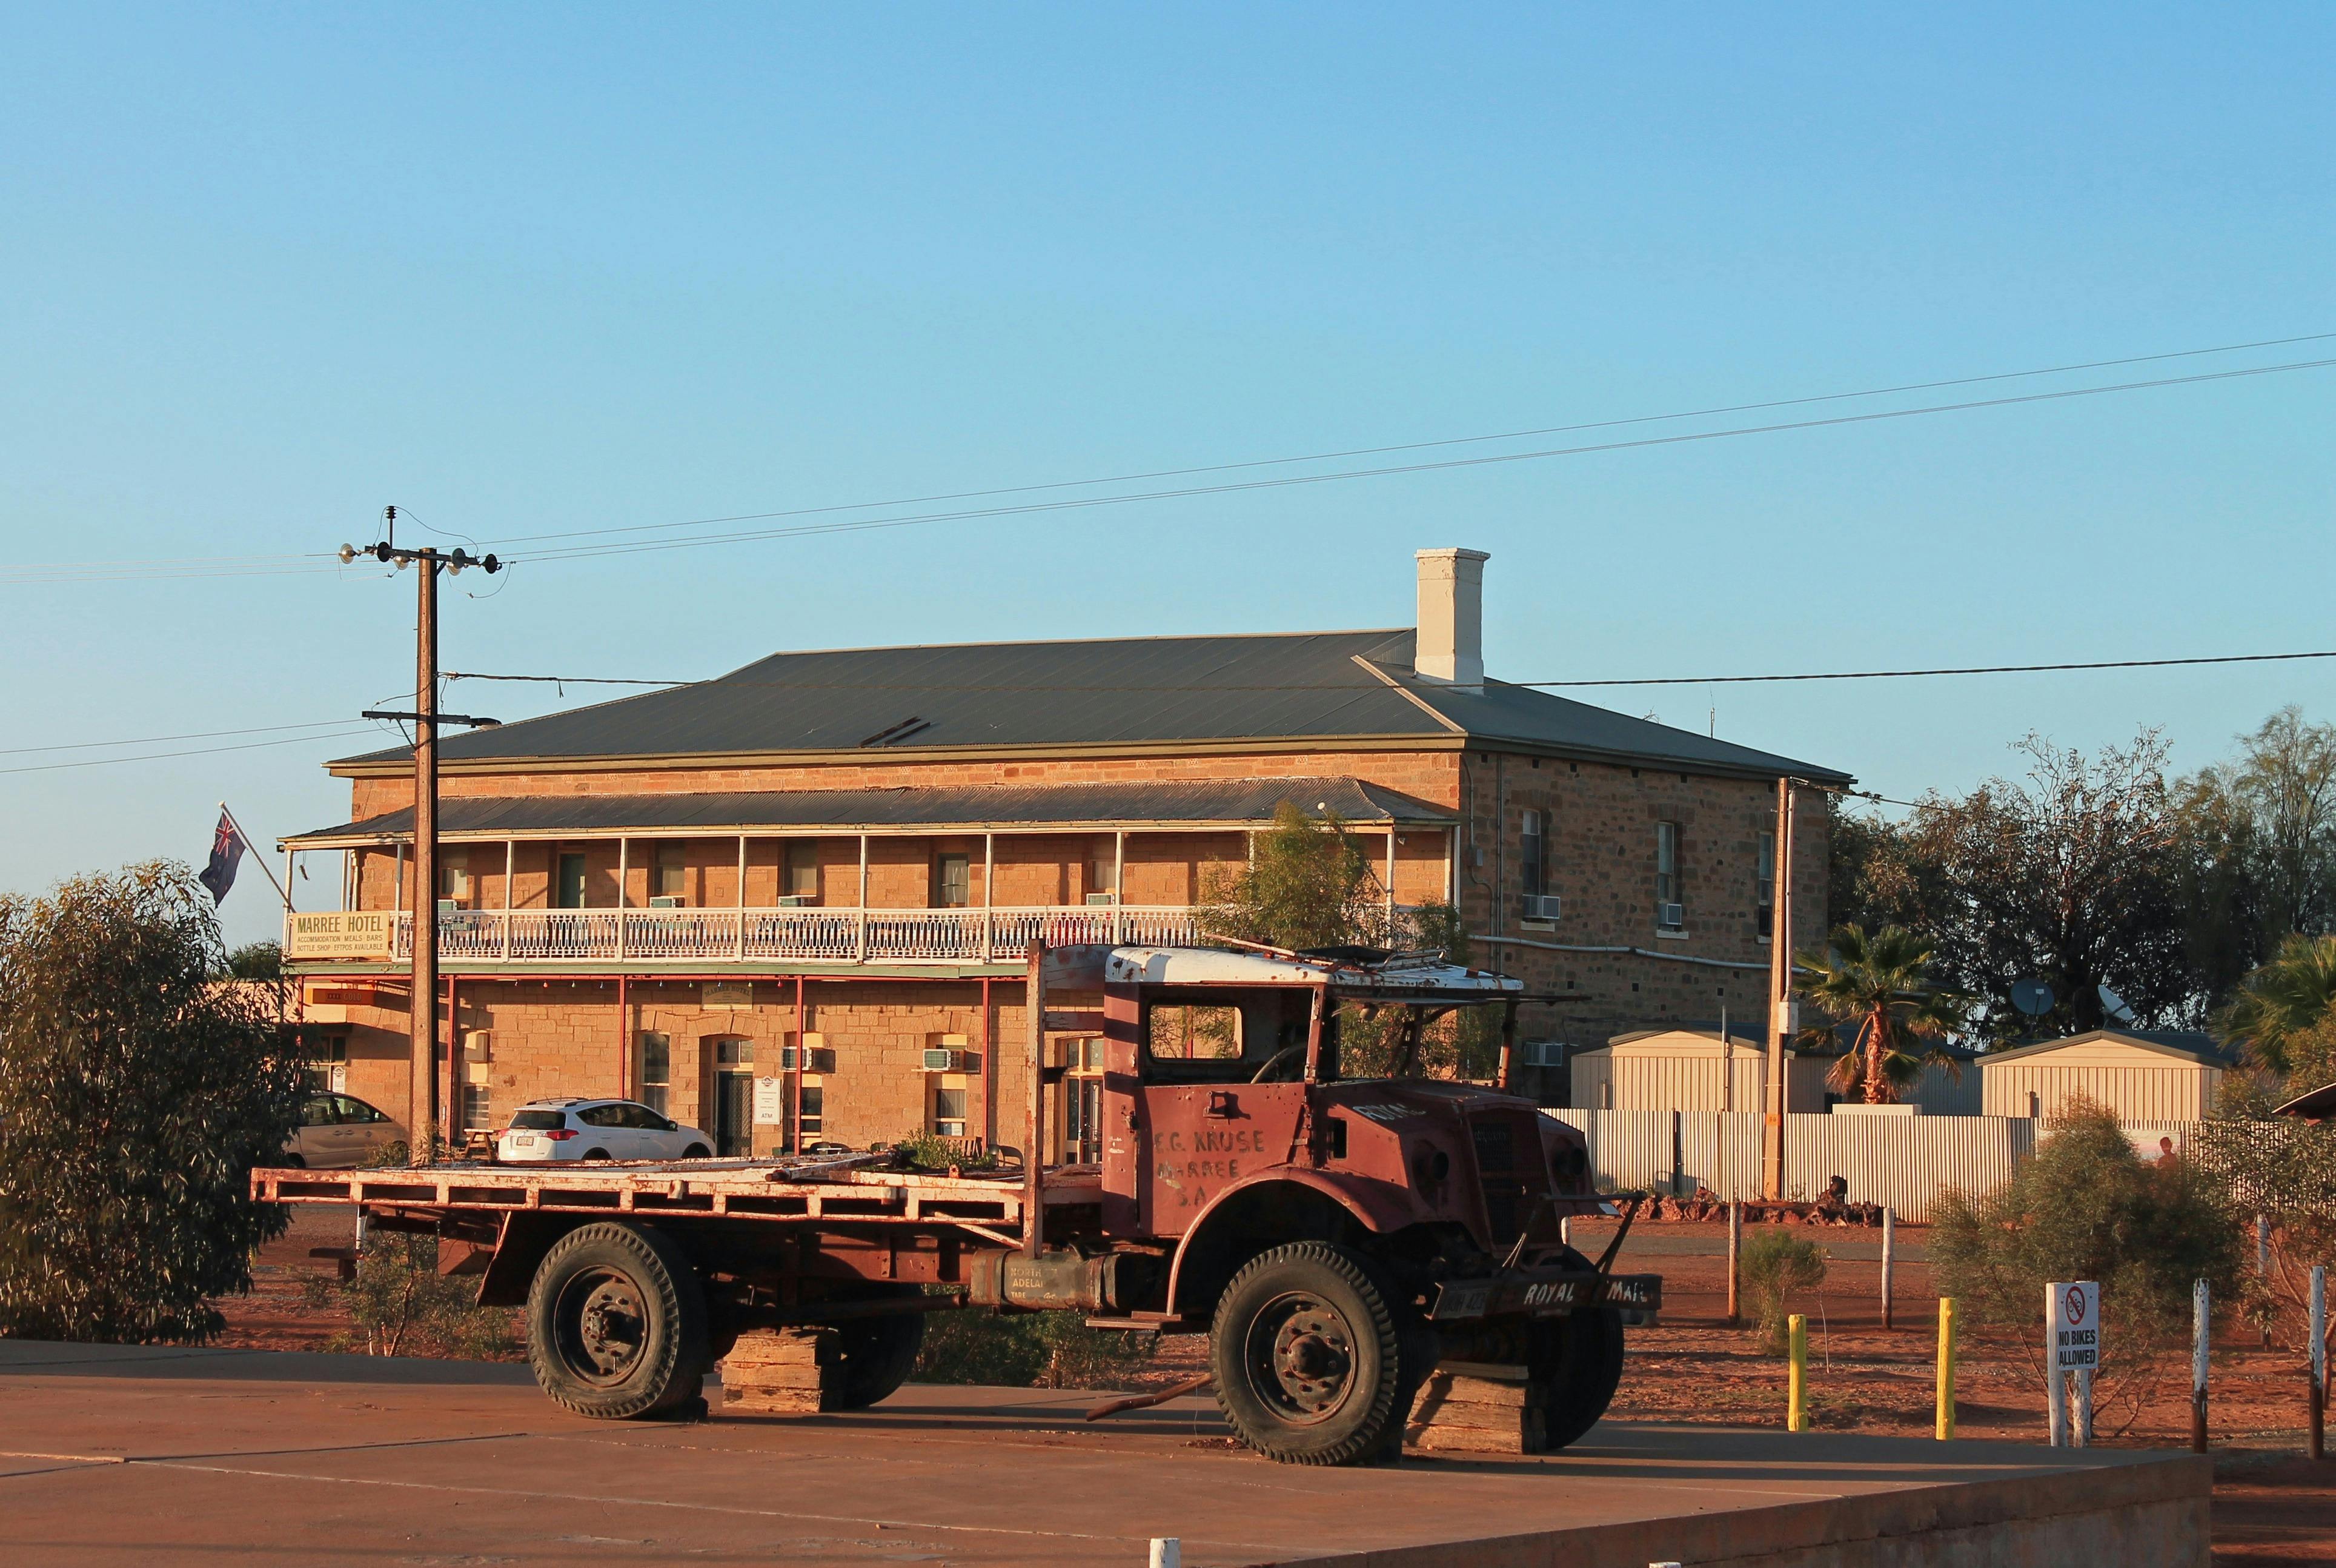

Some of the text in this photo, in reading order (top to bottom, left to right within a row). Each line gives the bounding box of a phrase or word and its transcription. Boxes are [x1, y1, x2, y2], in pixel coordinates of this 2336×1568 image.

[297, 915, 383, 933] MARREE HOTEL
[344, 992, 361, 1001] GOLD
[732, 985, 750, 996] HOTEL
[1194, 1131, 1264, 1152] KRUSE
[1010, 1267, 1041, 1277] NORTH
[1523, 1283, 1575, 1305] ROYAL
[2059, 1329, 2095, 1346] NO BIKES
[2059, 1349, 2095, 1366] ALLOWED
